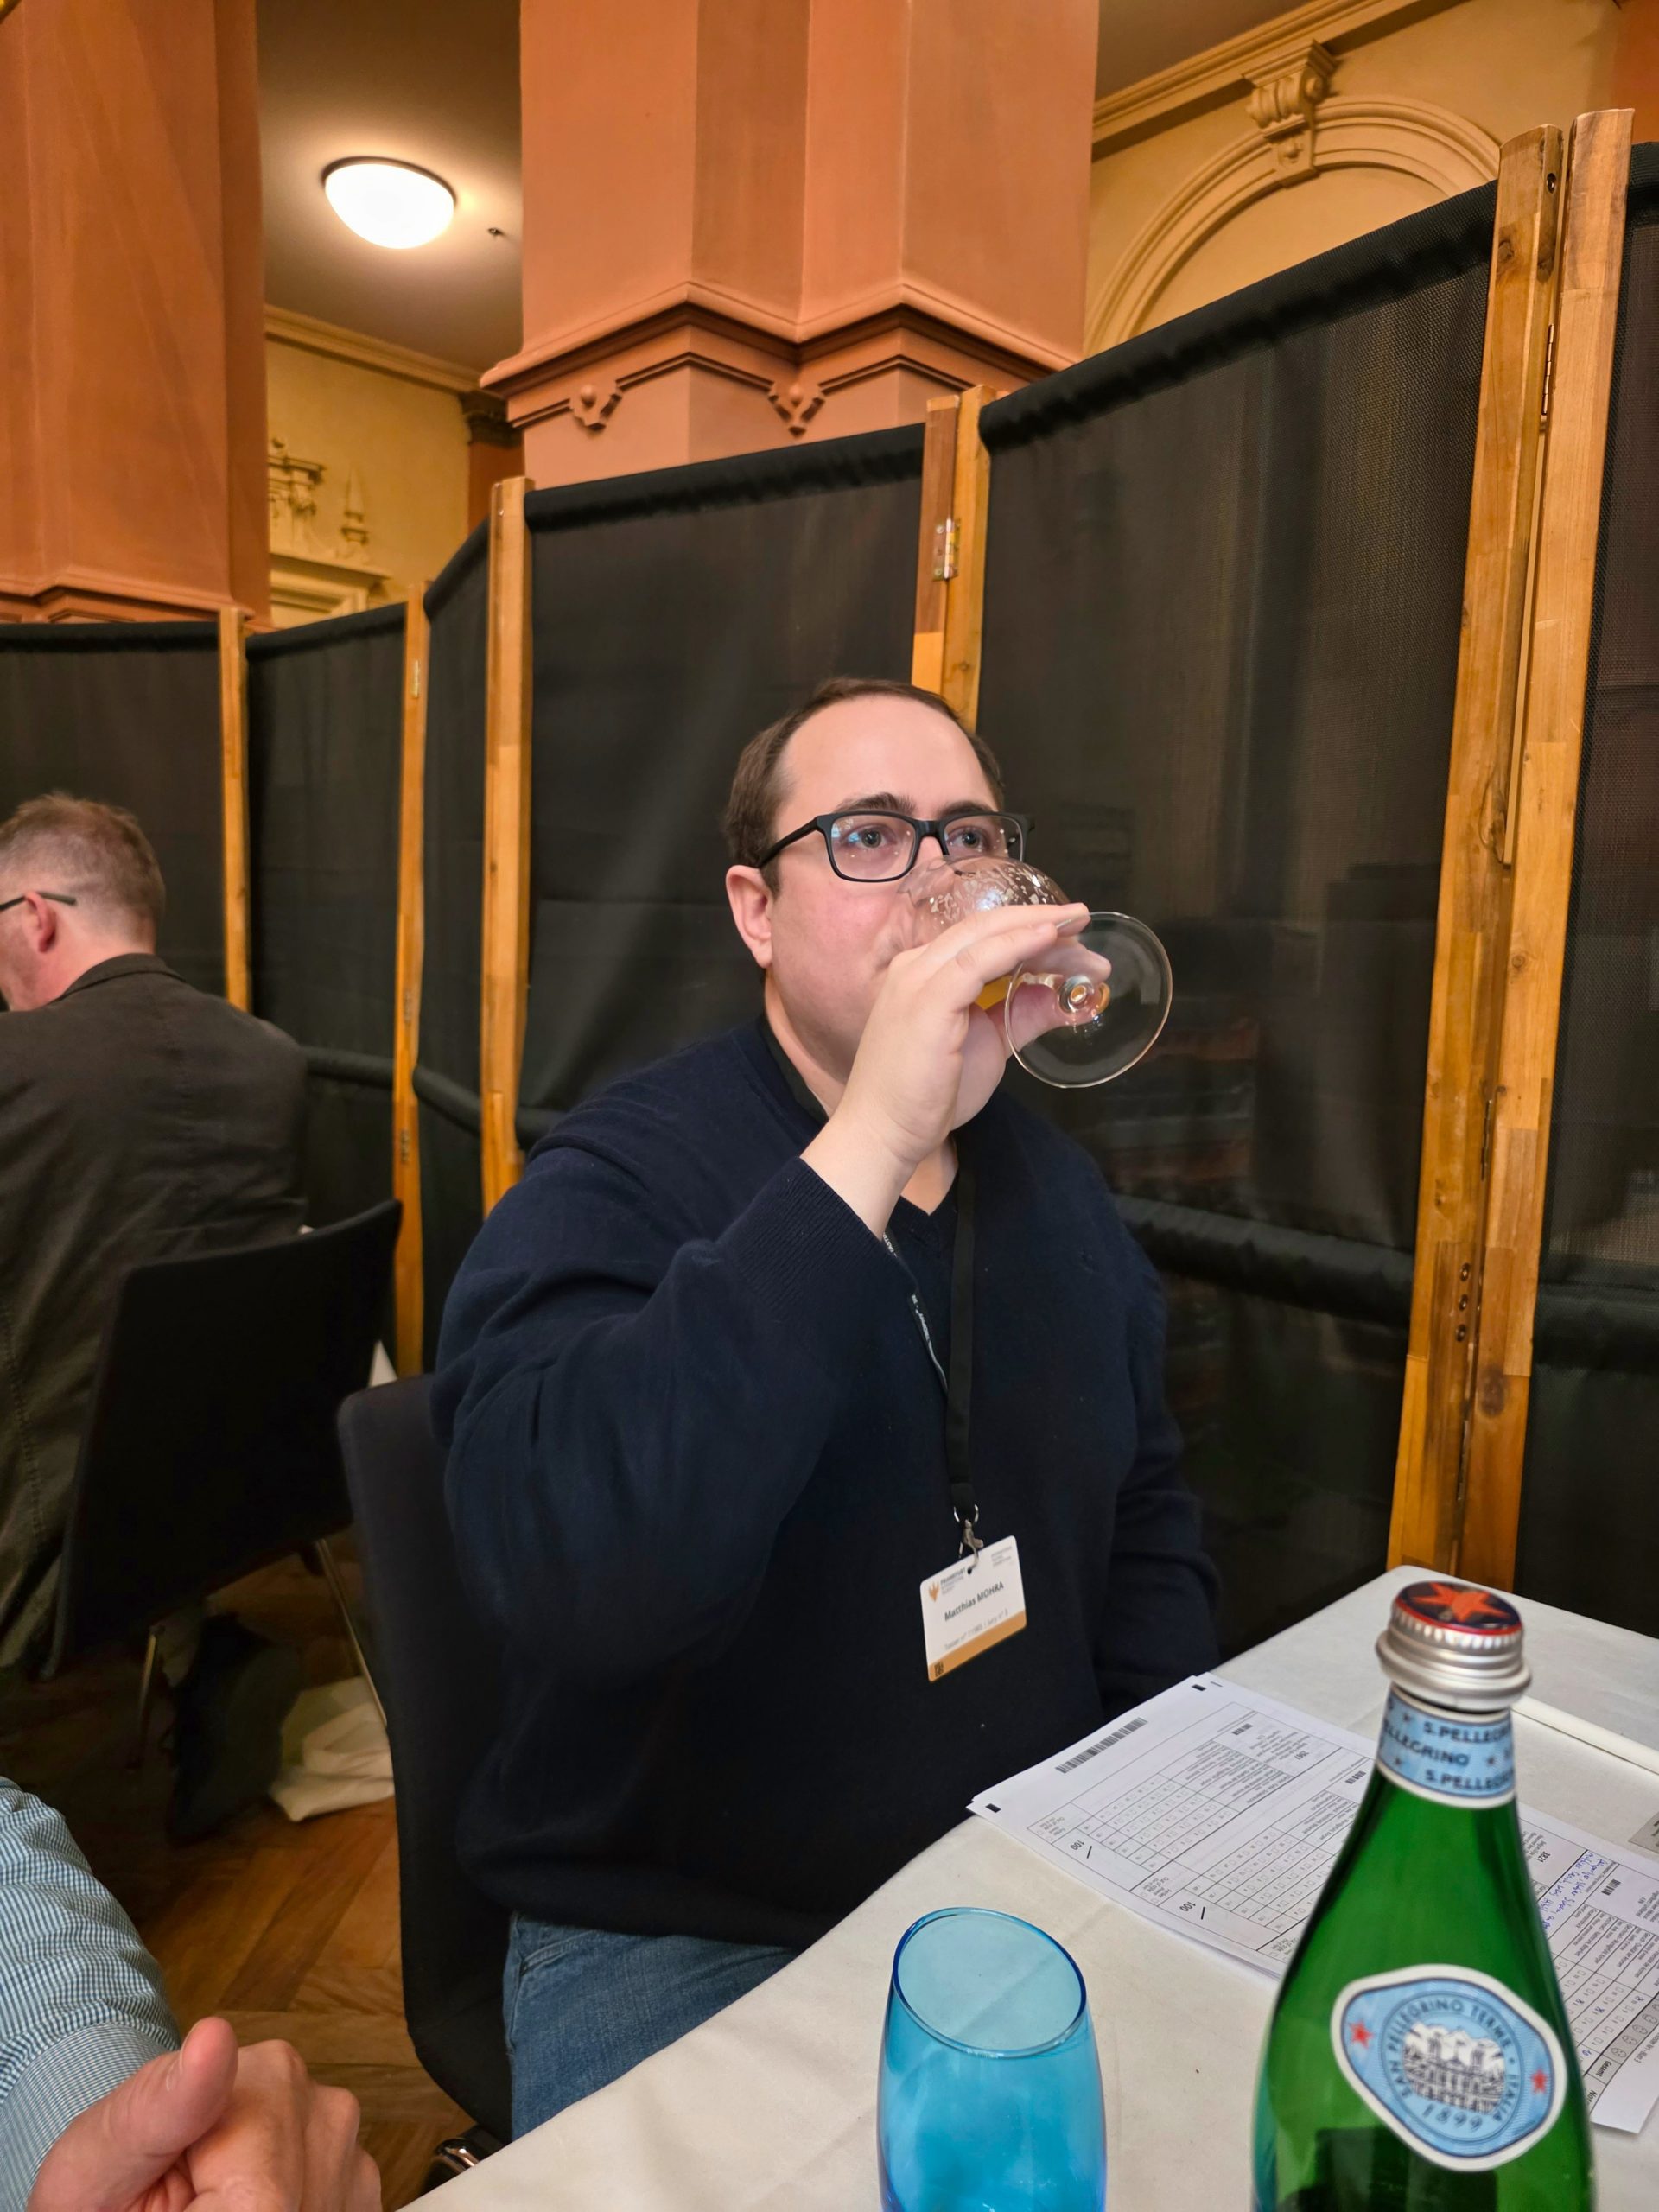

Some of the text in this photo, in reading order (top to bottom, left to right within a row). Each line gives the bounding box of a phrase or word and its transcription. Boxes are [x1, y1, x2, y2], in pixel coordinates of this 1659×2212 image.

[976, 1581, 1005, 1603] MOHRA
[1070, 1840, 1085, 1851] 100
[1537, 1851, 1552, 1862] 3821
[1179, 1901, 1198, 1912] 100
[1388, 1999, 1464, 2050] PELLEGRINO
[1471, 2005, 1512, 2050] TERME
[1389, 2060, 1411, 2099] SAN
[1596, 2060, 1612, 2077] Gesamt
[1422, 2101, 1483, 2133] 1899
